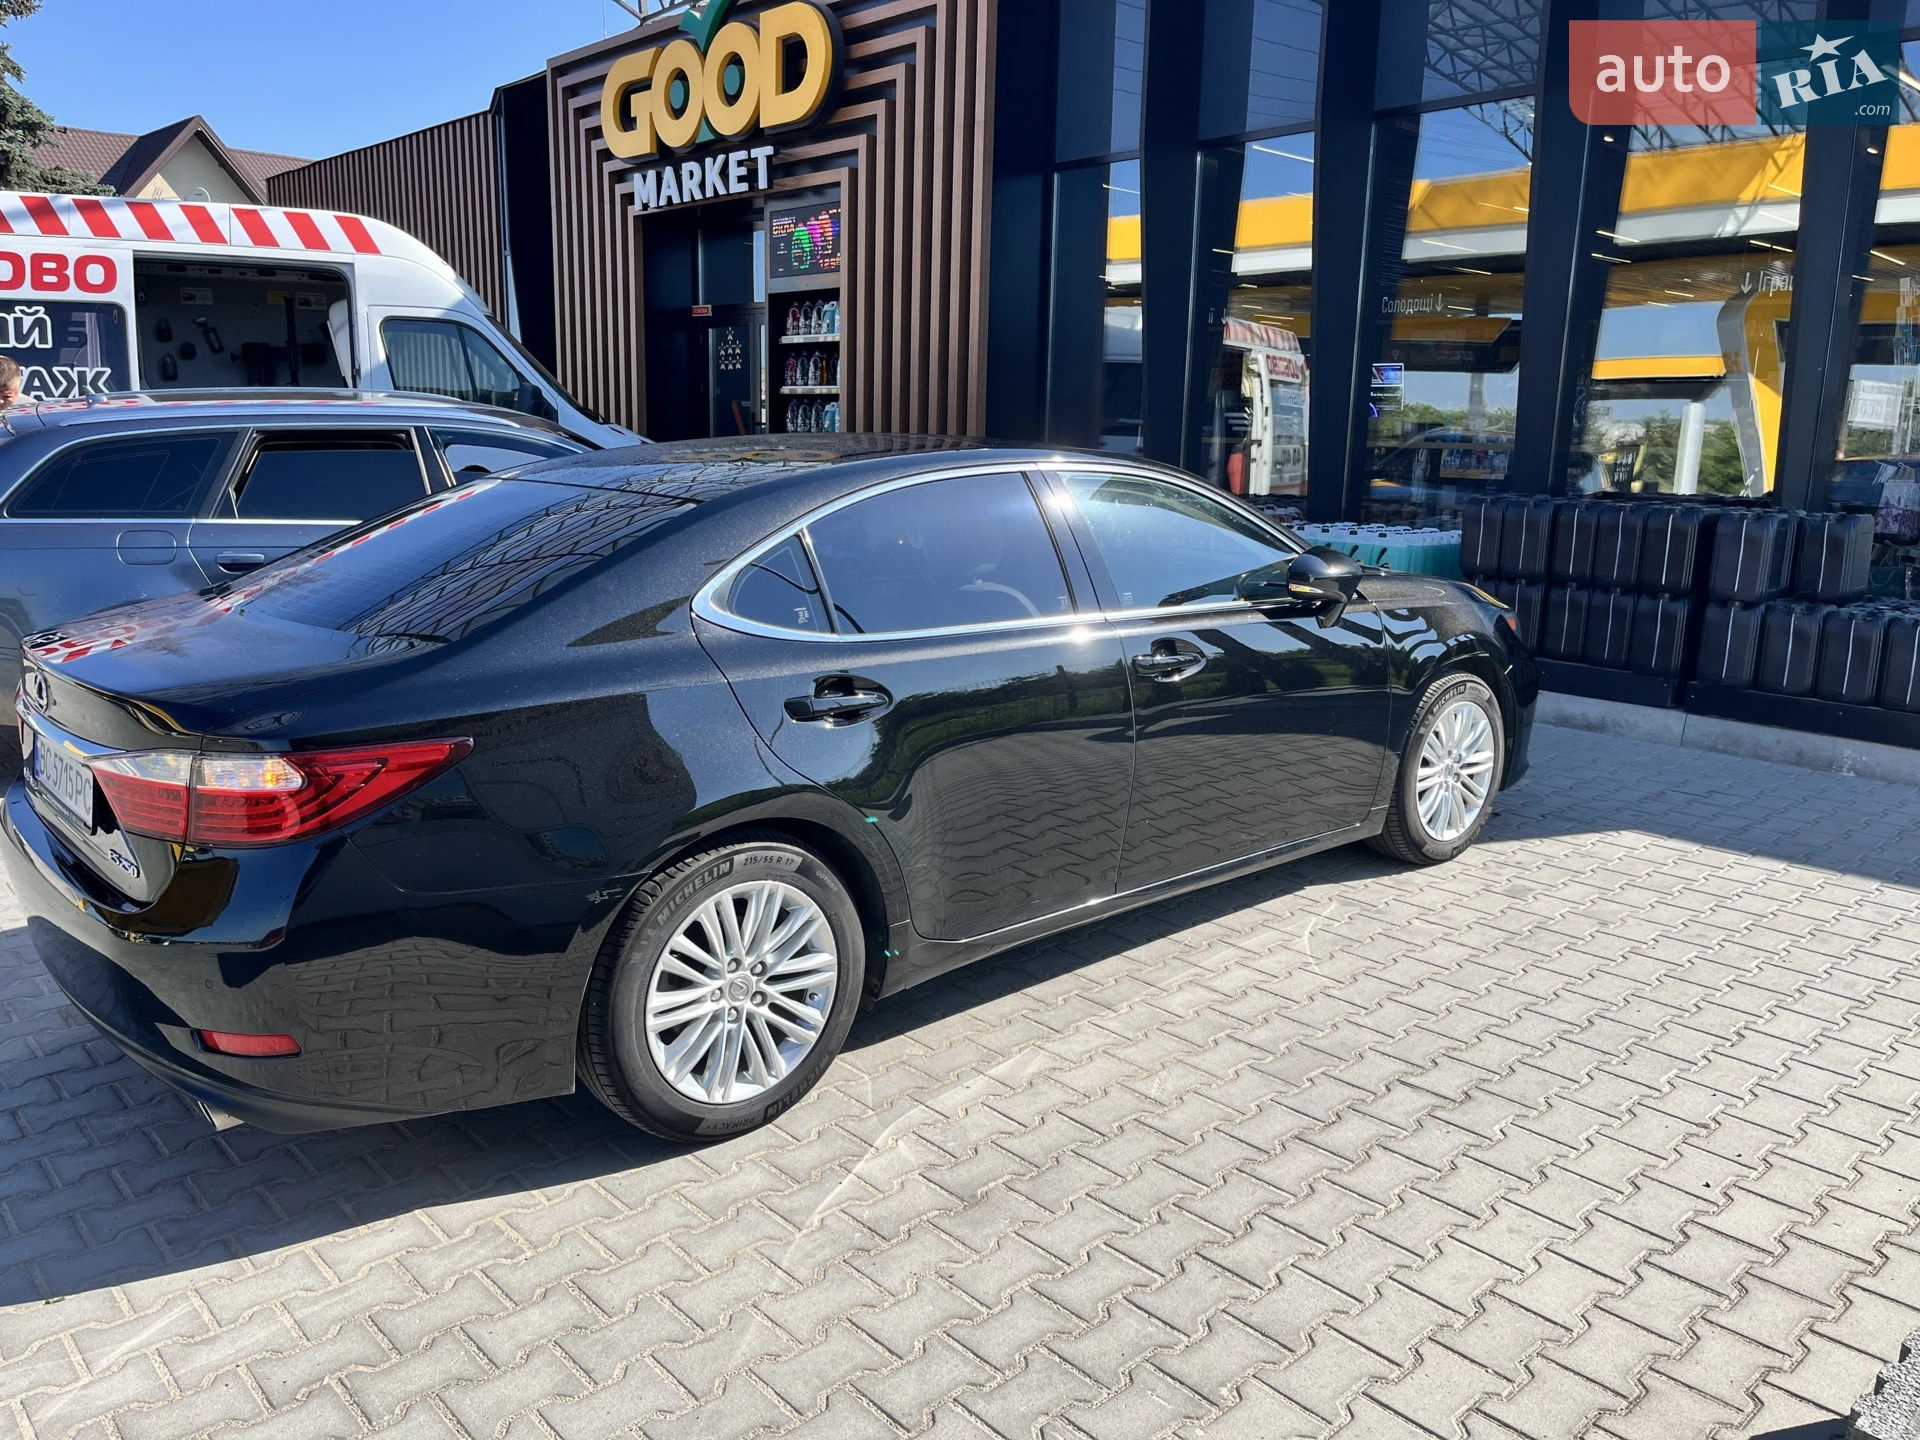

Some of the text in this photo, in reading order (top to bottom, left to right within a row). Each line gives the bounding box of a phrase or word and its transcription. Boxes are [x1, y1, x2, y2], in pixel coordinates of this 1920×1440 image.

[601, 1, 832, 158] GOOD
[634, 146, 774, 211] MARKET
[1381, 294, 1434, 315] Солодощі
[656, 856, 794, 926] MICHELIN 215/55 R 17
